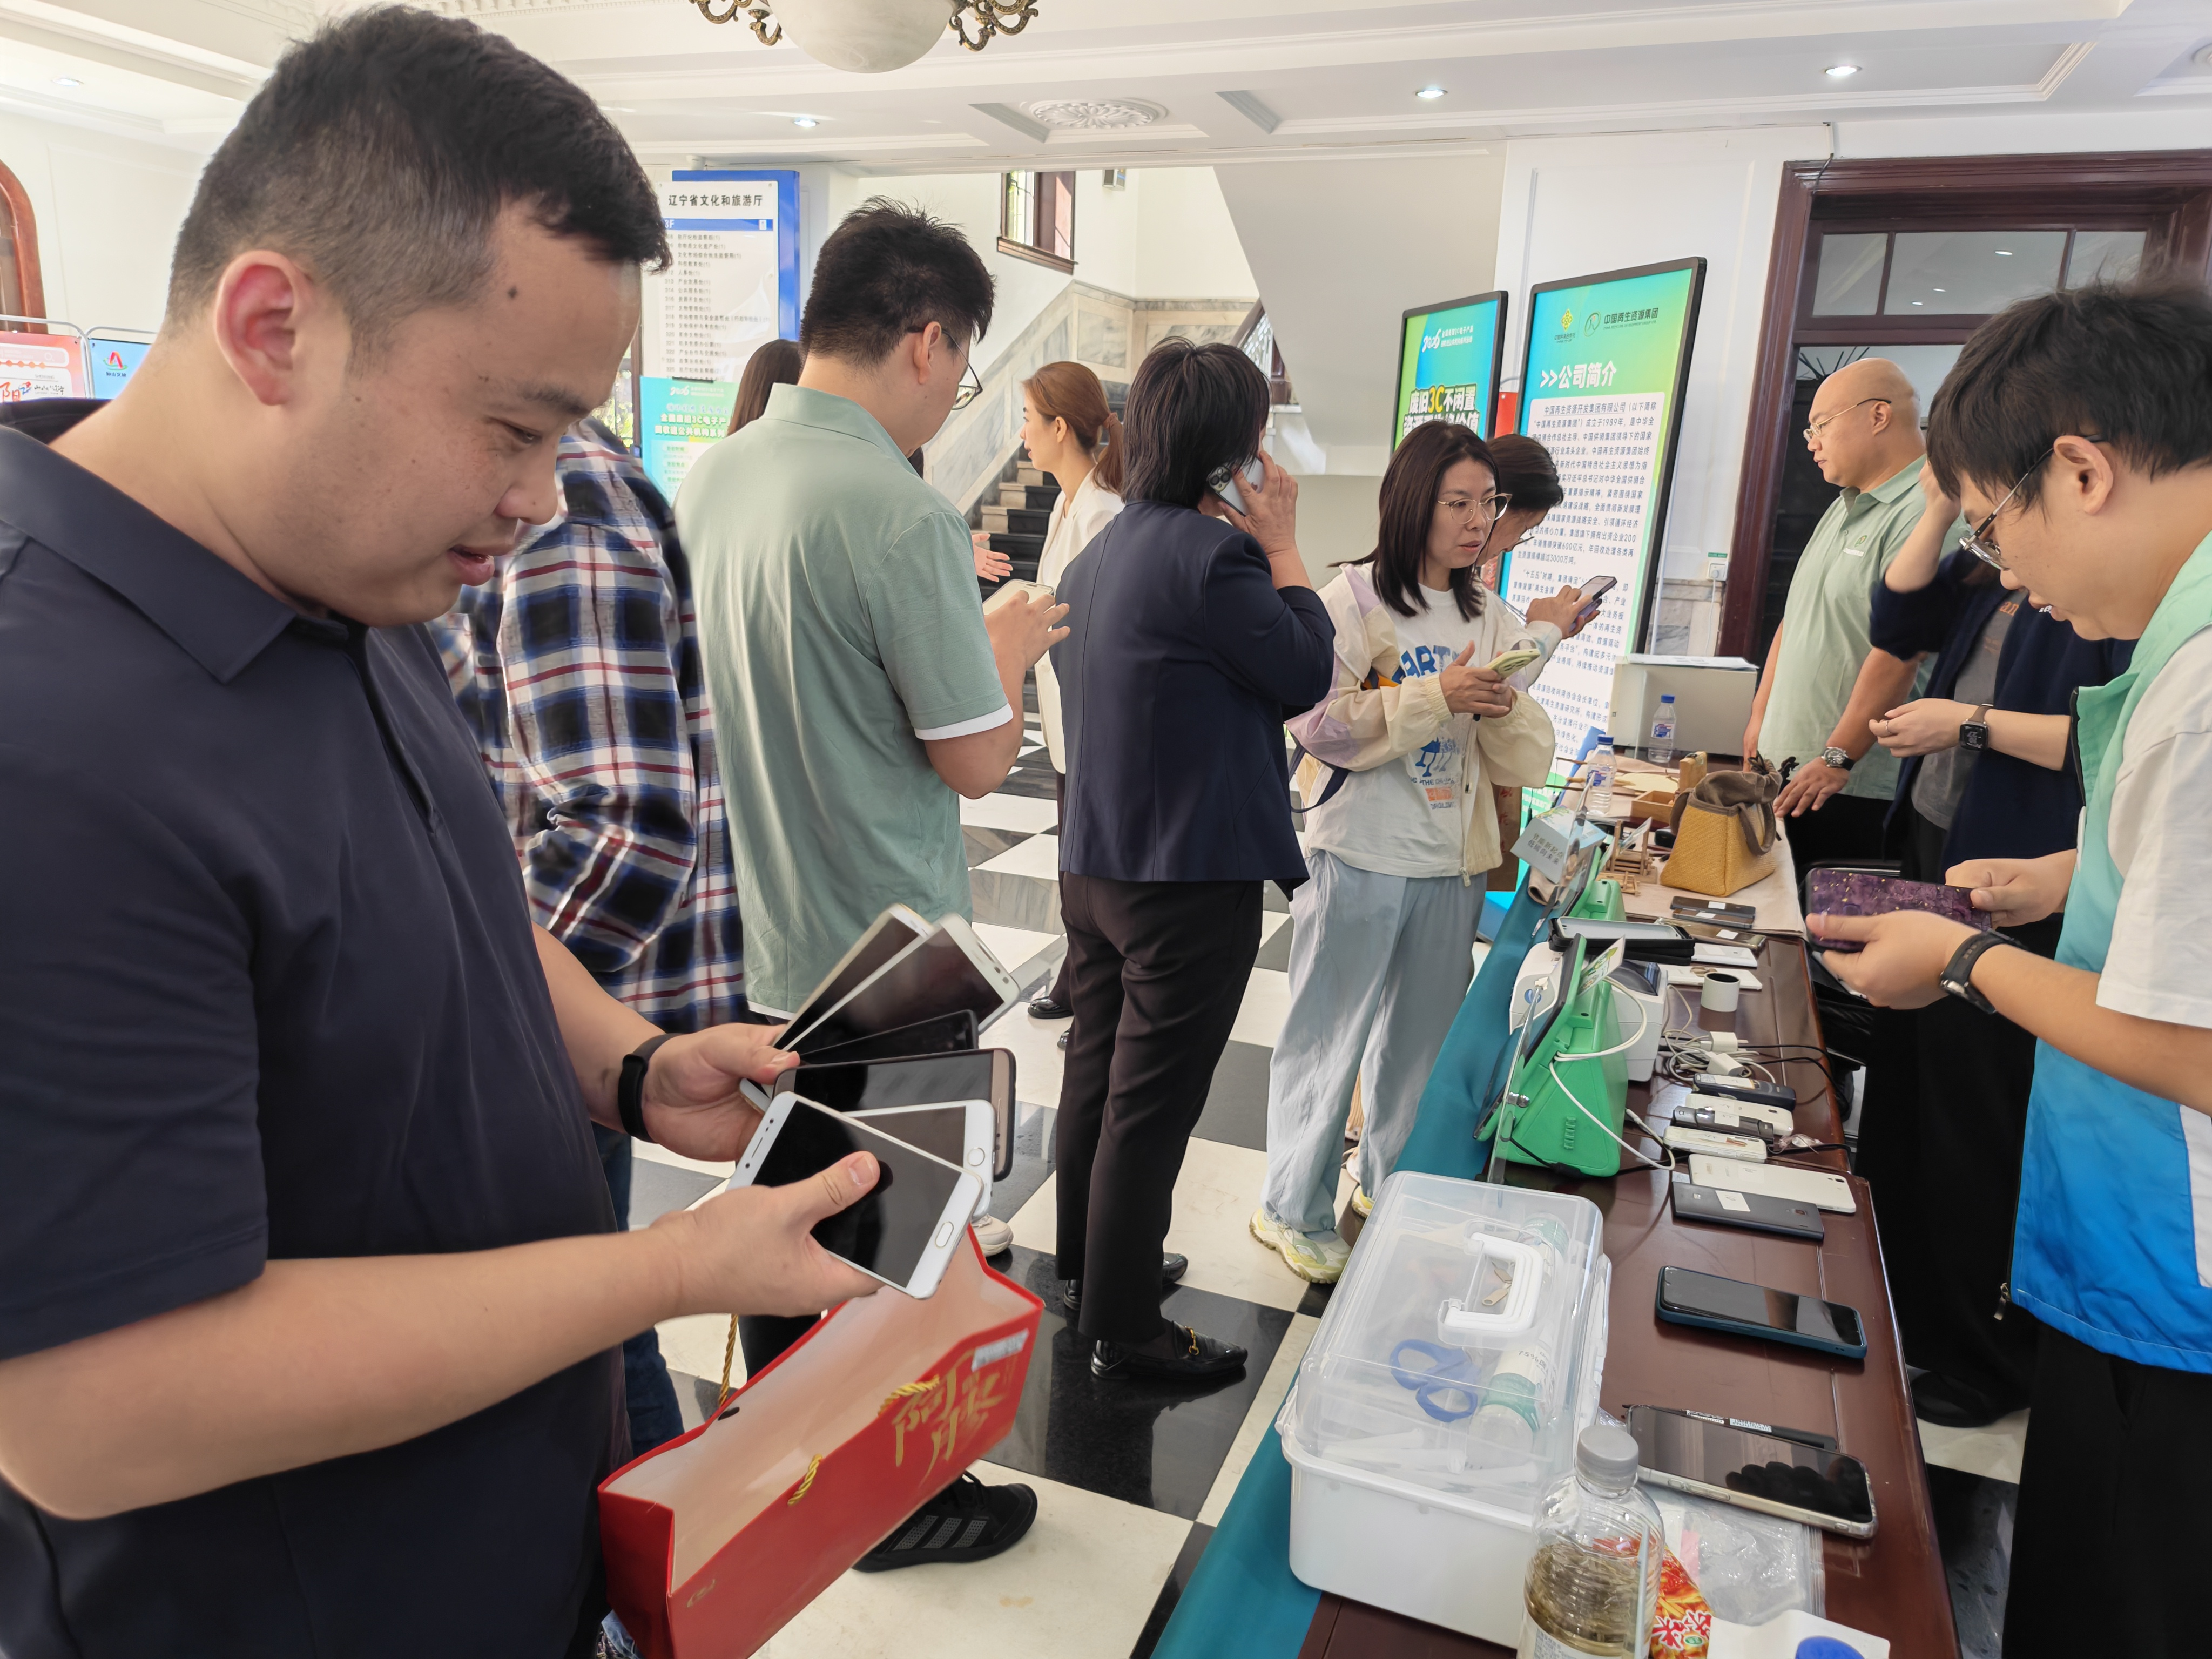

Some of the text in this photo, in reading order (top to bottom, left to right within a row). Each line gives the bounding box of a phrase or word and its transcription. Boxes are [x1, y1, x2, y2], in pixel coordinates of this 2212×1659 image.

[668, 194, 763, 207] 辽宁省文化和旅游厅
[1604, 307, 1658, 324] 中国再生资源集团
[1559, 360, 1617, 389] 公司简介
[1409, 384, 1476, 414] 废旧3C不闲置
